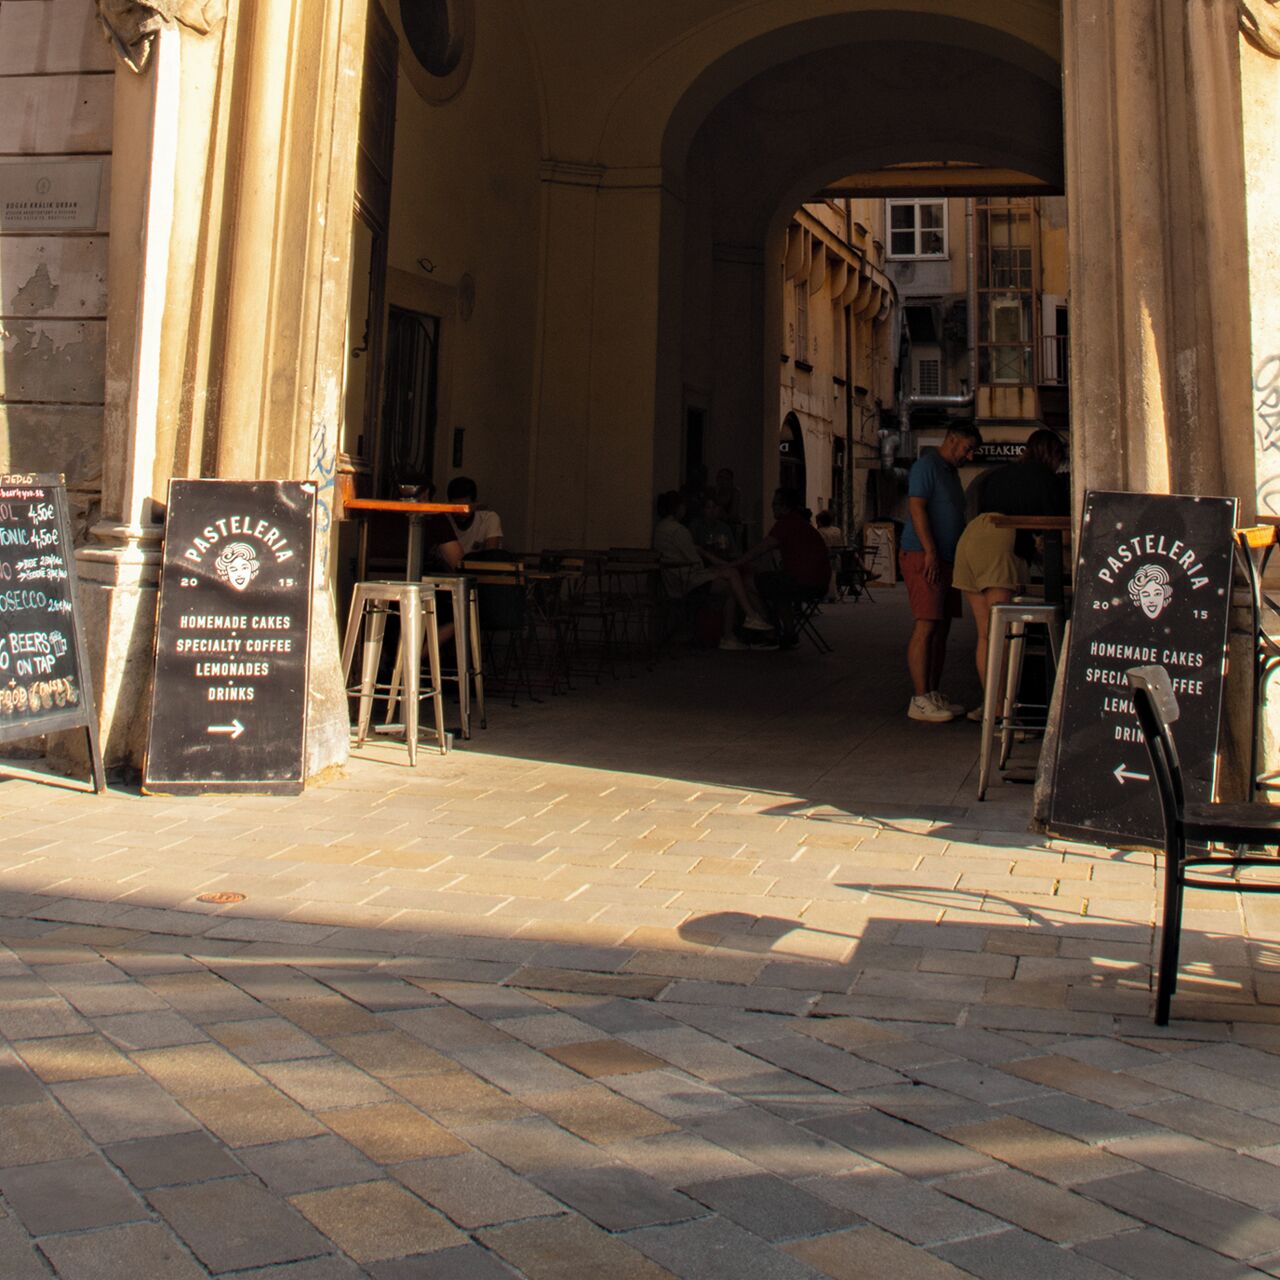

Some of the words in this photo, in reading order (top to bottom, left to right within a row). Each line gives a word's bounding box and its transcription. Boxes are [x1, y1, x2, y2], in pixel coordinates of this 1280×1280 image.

[975, 445, 1026, 456] STEAKHO
[28, 503, 55, 525] 4,50€
[30, 528, 59, 550] 4,50€
[184, 515, 294, 564] PASTELERIA
[1098, 533, 1210, 591] PASTELERIA
[180, 577, 198, 588] 20
[278, 577, 294, 588] 15
[1092, 600, 1109, 610] 20
[1193, 609, 1208, 620] 15
[180, 615, 247, 629] HOMEMADE
[251, 615, 290, 629] CAKES
[9, 632, 51, 654] BEERS
[176, 639, 241, 652] SPECIALTY
[246, 639, 291, 652] COFFEE
[1090, 642, 1157, 663] HOMEMADE
[1163, 649, 1204, 667] CAKES
[16, 658, 33, 676] ON
[33, 655, 56, 675] TAP
[196, 662, 269, 676] LEMONADES
[1086, 668, 1129, 686] SPECIA
[1172, 678, 1204, 695] FFEE
[207, 687, 255, 701] DRINKS
[1115, 726, 1144, 744] DRIN
